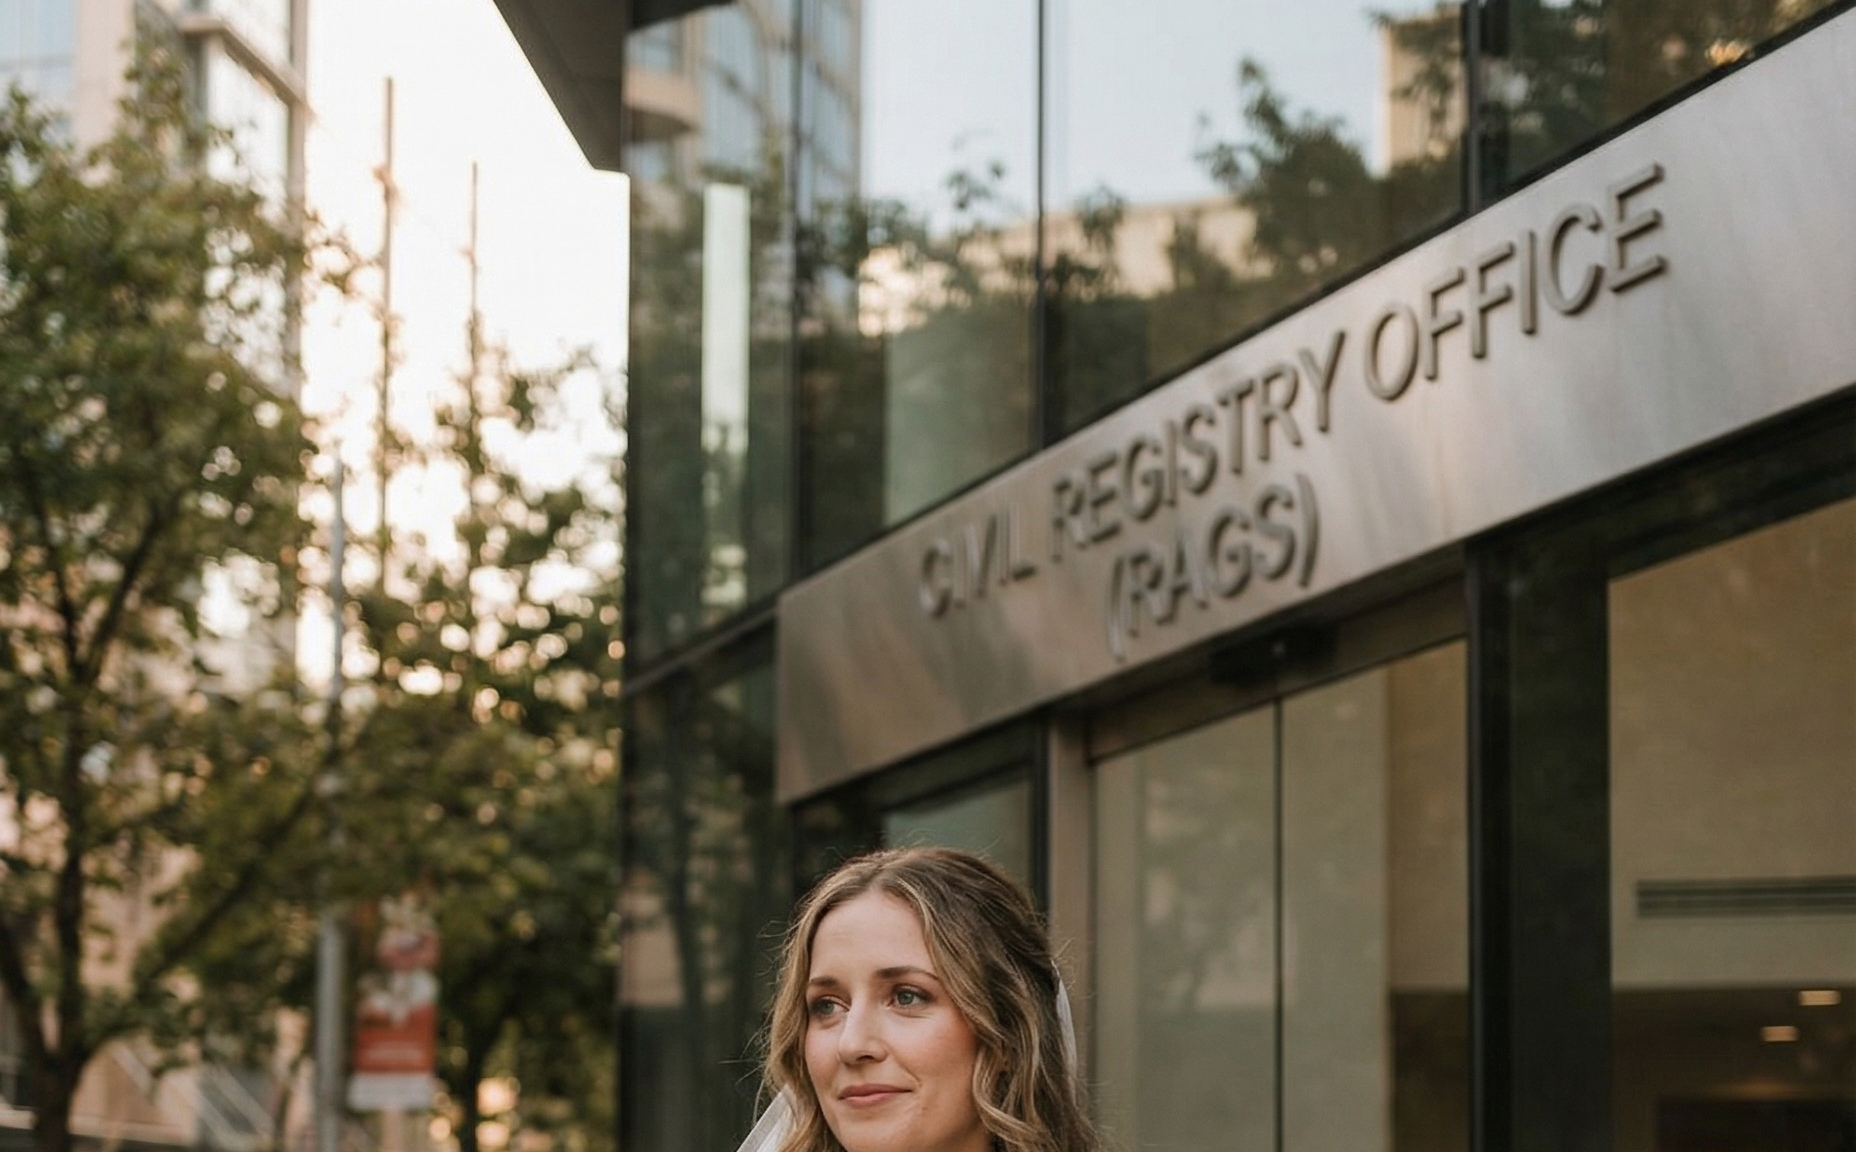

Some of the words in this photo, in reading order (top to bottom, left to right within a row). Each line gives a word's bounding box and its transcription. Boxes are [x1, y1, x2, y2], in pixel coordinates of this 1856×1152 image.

[919, 502, 1038, 620] CIVIL
[1052, 330, 1346, 562] REGISTRY
[1363, 161, 1668, 402] OFFICE
[1108, 472, 1322, 662] (RAGS)
